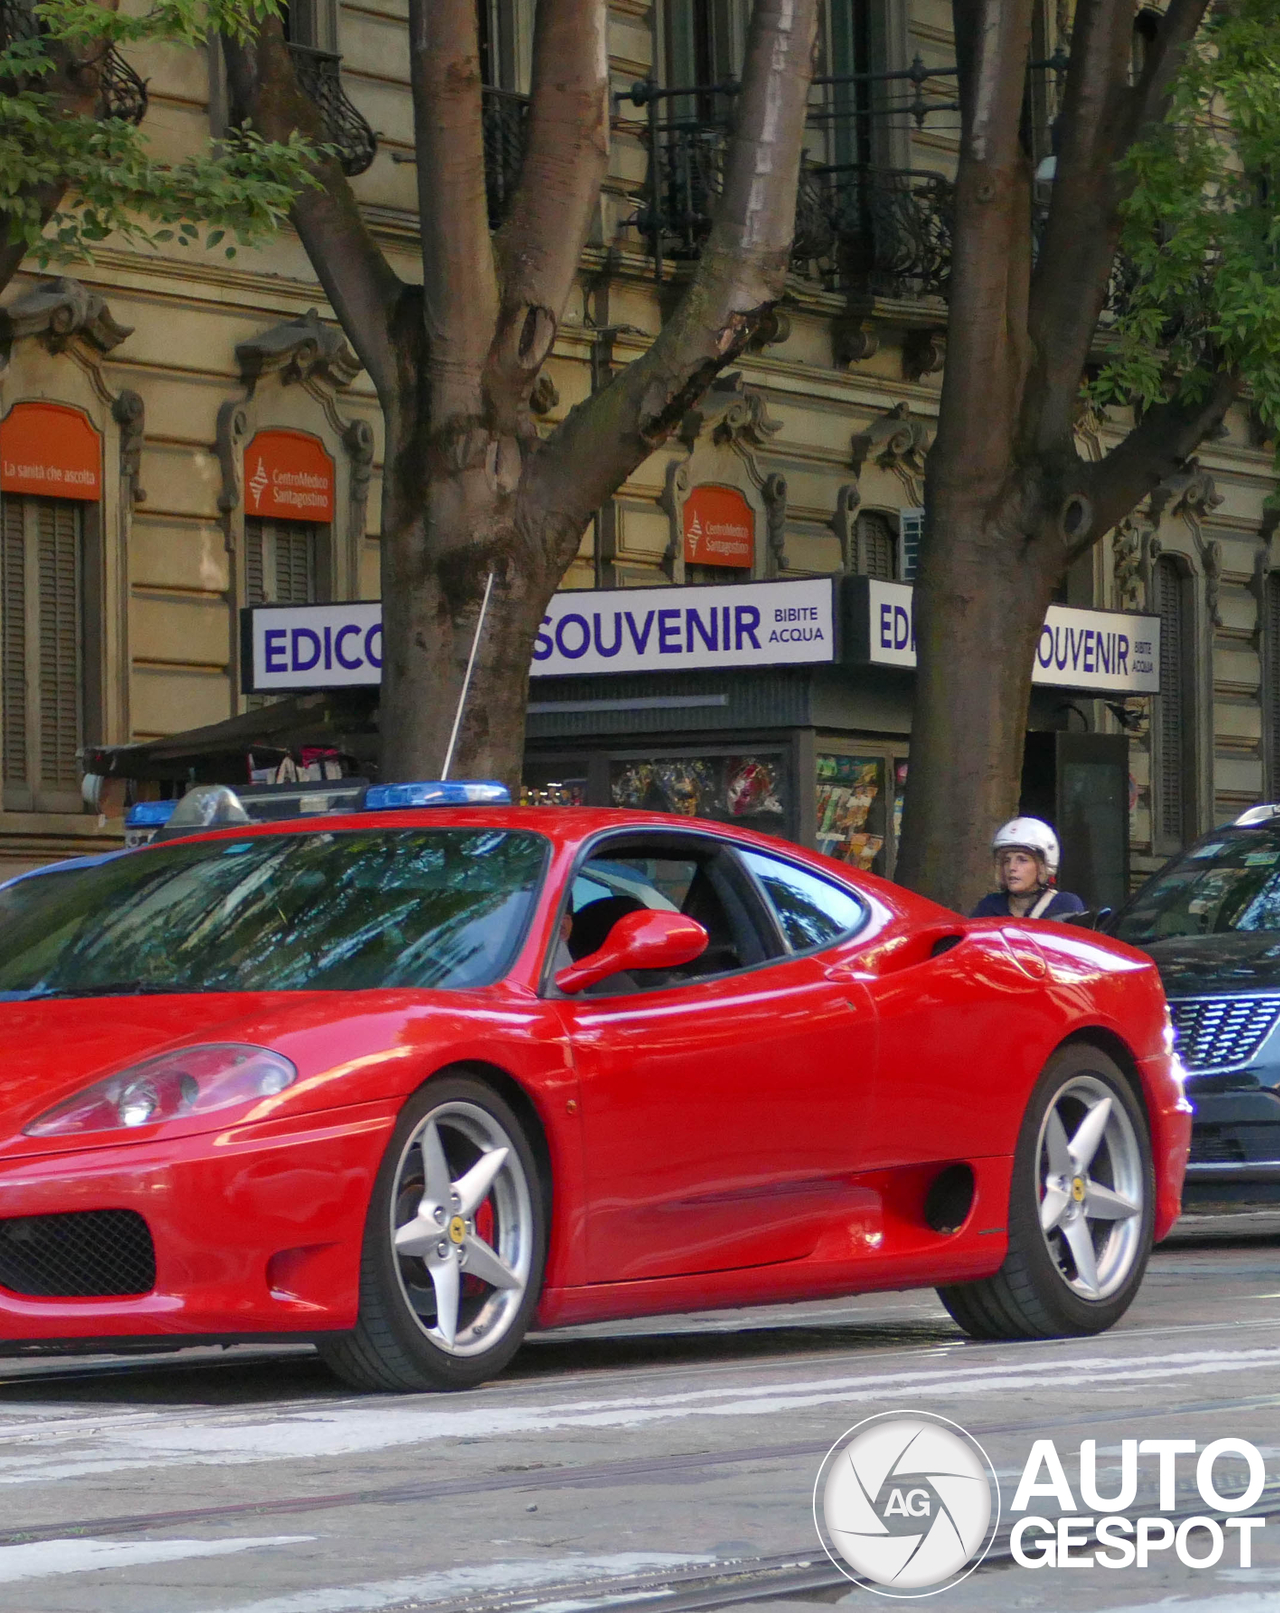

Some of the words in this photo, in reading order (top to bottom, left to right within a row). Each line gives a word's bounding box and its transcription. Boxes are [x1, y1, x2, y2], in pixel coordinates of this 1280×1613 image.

[3, 460, 16, 477] La
[774, 607, 818, 622] BIBITE
[531, 605, 762, 661] SOUVENIR
[768, 627, 824, 643] ACQUA
[1036, 624, 1129, 676] OUVENIR
